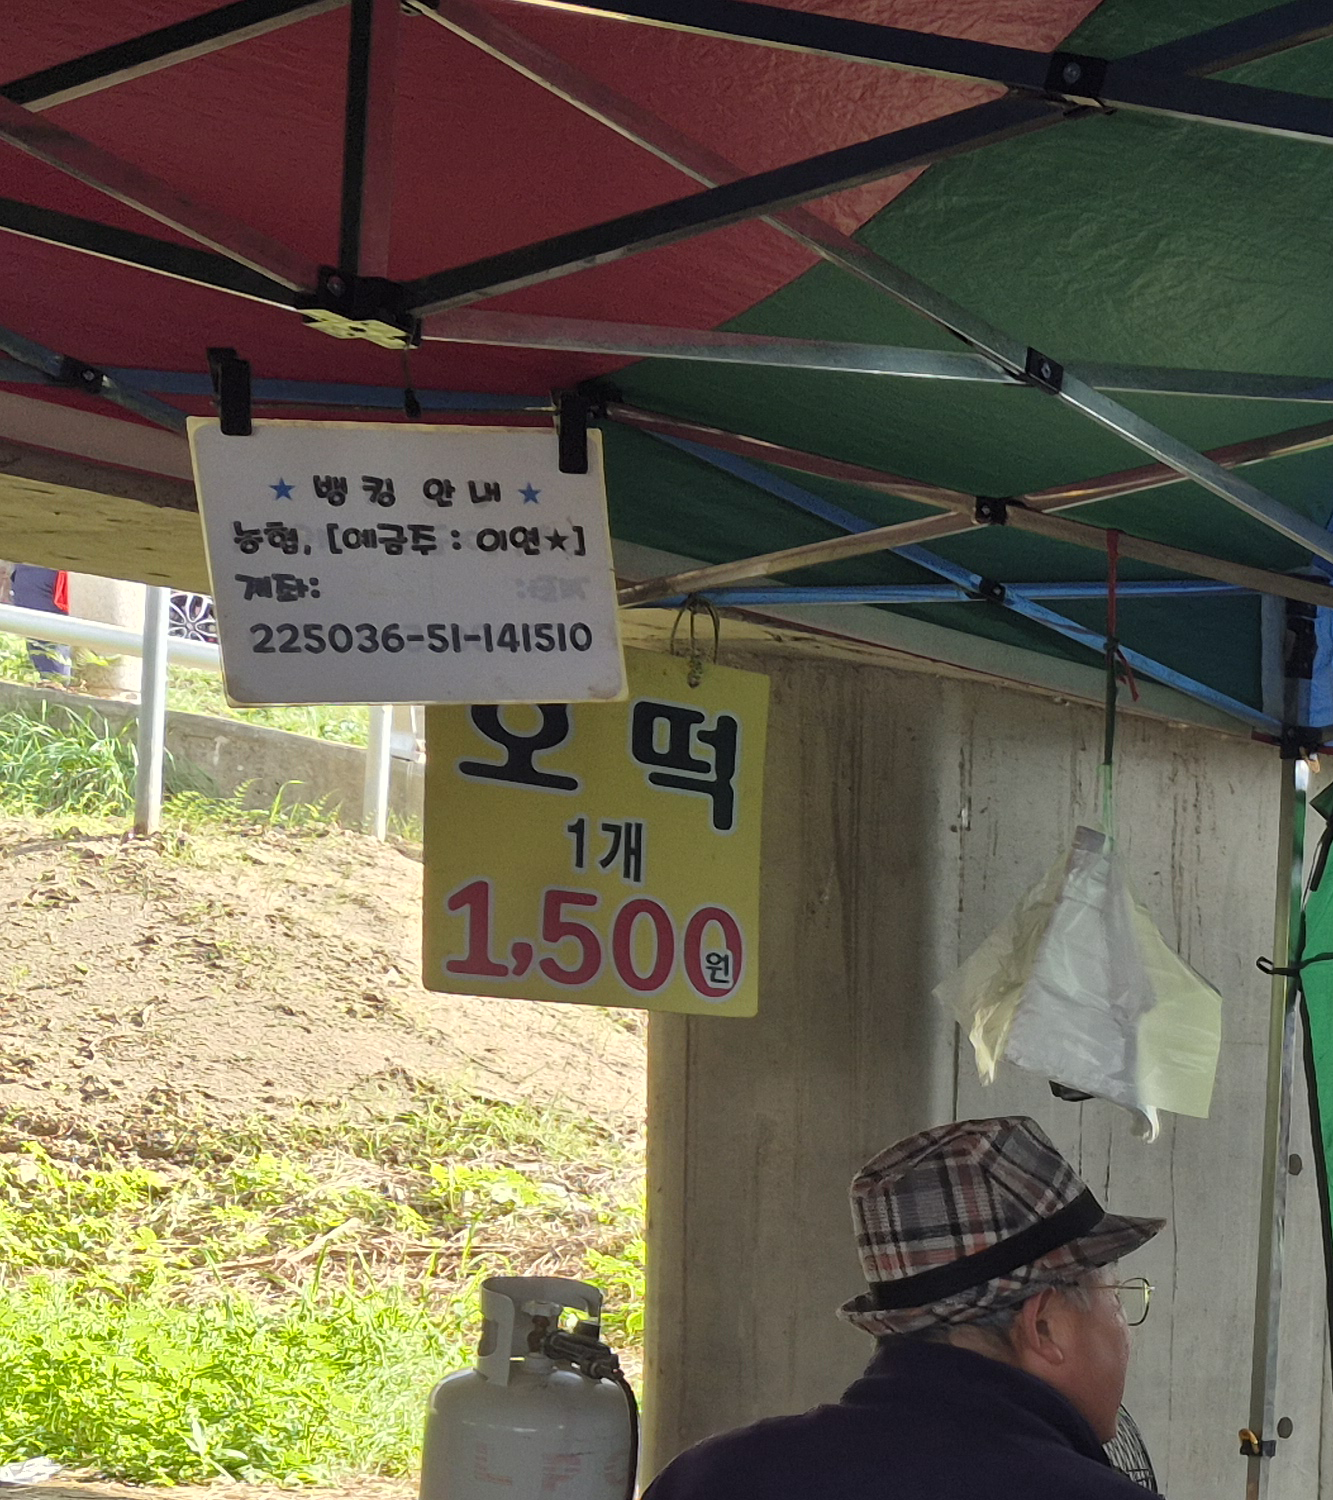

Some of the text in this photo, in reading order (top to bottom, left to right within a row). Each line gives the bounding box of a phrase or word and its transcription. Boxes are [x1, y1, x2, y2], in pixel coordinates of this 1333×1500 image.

[312, 474, 502, 508] 뱅킹 안내
[232, 520, 312, 557] 농협,
[249, 621, 594, 654] 225036-51-141510
[567, 818, 643, 883] 1개
[446, 880, 742, 998] 1,500
